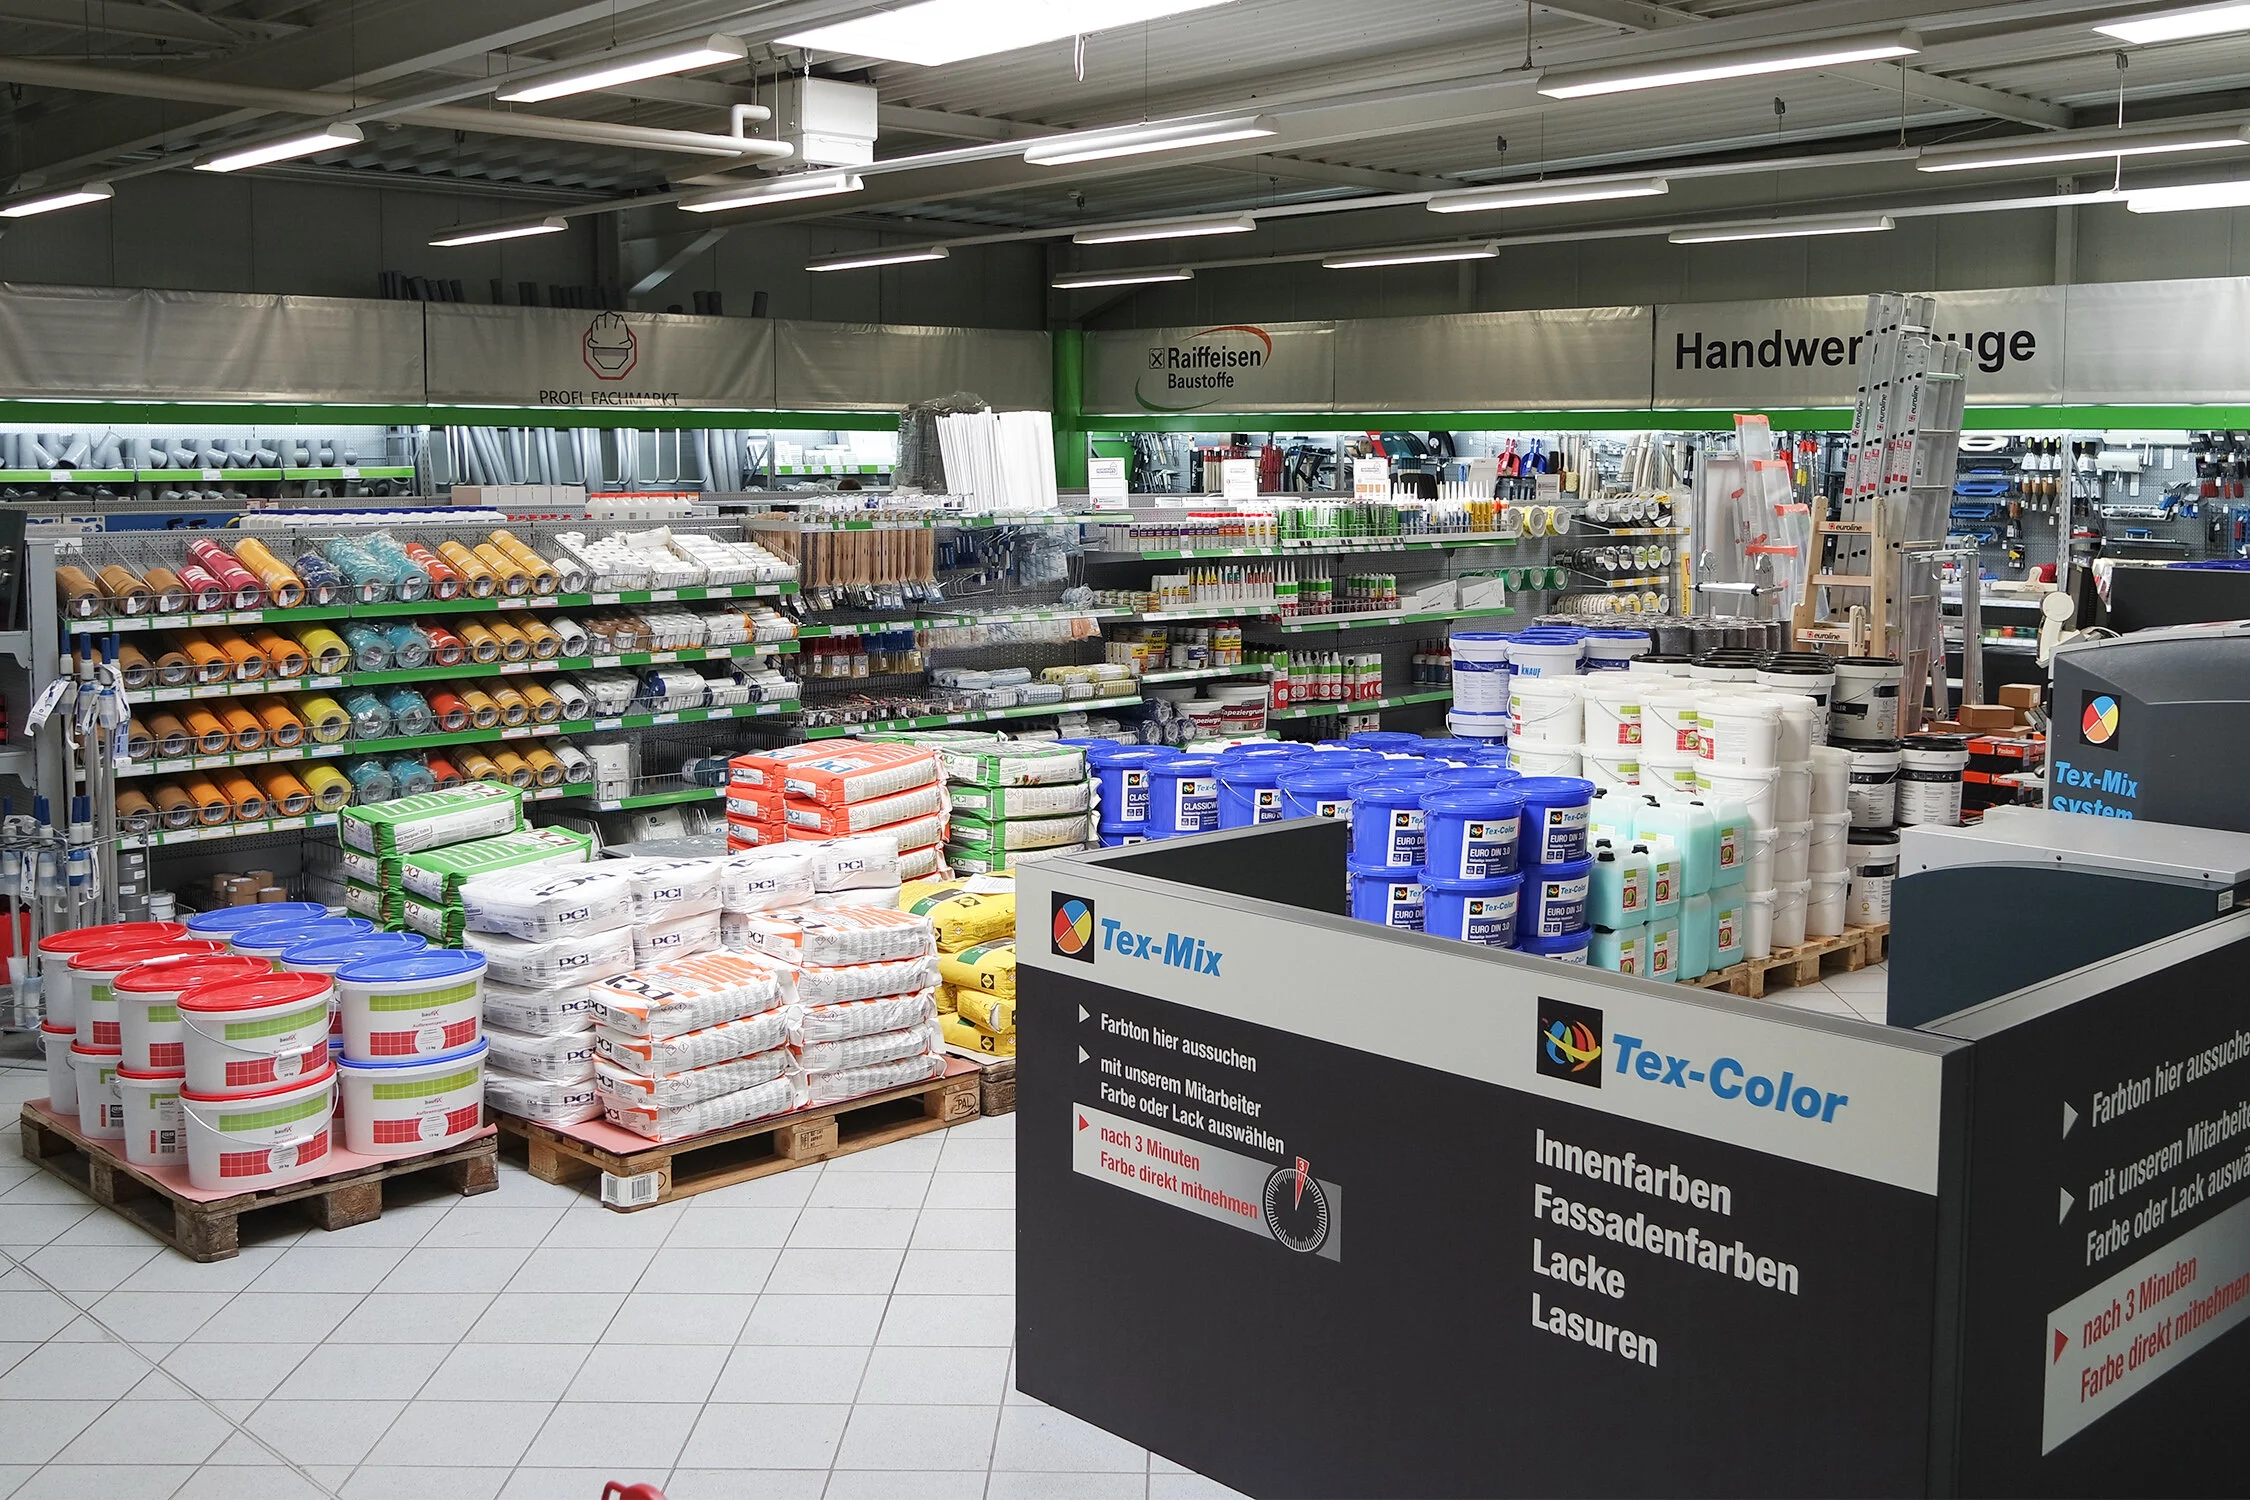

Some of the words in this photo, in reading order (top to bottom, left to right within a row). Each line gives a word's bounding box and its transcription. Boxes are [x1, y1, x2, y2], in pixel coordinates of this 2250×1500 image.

[1167, 345, 1262, 369] Raiffeisen
[1168, 371, 1235, 389] Baustoffe
[539, 390, 584, 405] PROFI
[591, 391, 679, 406] FACHMARKT
[1911, 385, 1920, 414] euroline
[1879, 394, 1888, 423] euroline
[1835, 523, 1862, 531] euroline
[1813, 631, 1841, 641] euroline
[1197, 784, 1217, 792] Tex-C
[2055, 761, 2139, 799] Tex-Mix
[1183, 802, 1218, 811] CLASSICW
[1485, 825, 1516, 835] Tex-Color
[1550, 834, 1568, 843] EURO
[1568, 833, 1577, 842] DIN
[1396, 836, 1416, 846] EURO
[1469, 848, 1489, 858] EURO
[1490, 848, 1501, 857] DIN
[1502, 846, 1511, 856] 3.0
[838, 860, 863, 871] PCI
[748, 880, 776, 892] PCI
[653, 888, 682, 901] PCI
[1394, 910, 1414, 919] EURO
[1484, 901, 1515, 912] Tex-Color
[1546, 906, 1564, 917] EURO
[1565, 905, 1575, 915] DIN
[1575, 903, 1583, 914] 3.0
[558, 907, 589, 923] PCI
[1469, 924, 1490, 934] EURO
[1491, 923, 1502, 933] DIN
[652, 934, 681, 948] PCI
[1101, 917, 1223, 977] Tex-Mix
[559, 953, 590, 968] PCI
[561, 1000, 589, 1013] PC
[588, 999, 607, 1016] PCI
[1101, 1013, 1149, 1044] Farbton
[1153, 1026, 1179, 1051] hier
[1182, 1037, 1257, 1073] aussuchen
[1612, 1034, 1849, 1124] Tex-Color
[1101, 1057, 1122, 1080] mit
[1125, 1066, 1181, 1095] unserem
[1186, 1078, 1262, 1119] Mitarbeiter
[2092, 1076, 2151, 1128] Farbton
[2155, 1062, 2183, 1093] hier
[564, 1092, 594, 1104] PCI
[1100, 1082, 1136, 1109] Farbe
[1139, 1097, 1169, 1119] oder
[1172, 1106, 1205, 1130] Lack
[1208, 1117, 1285, 1154] auswählen
[1101, 1127, 1131, 1149] nach
[1135, 1136, 1143, 1152] 3
[1147, 1139, 1200, 1172] Minuten
[1298, 1160, 1306, 1172] 3
[1535, 1128, 1732, 1217] Innenfarben
[2088, 1170, 2115, 1211] mit
[2119, 1140, 2183, 1196] unserem
[1100, 1151, 1135, 1178] Farbe
[1139, 1165, 1178, 1192] direkt
[1181, 1181, 1258, 1219] mitnehmen
[2086, 1219, 2130, 1267] Farbe
[2134, 1199, 2167, 1233] oder
[2170, 1172, 2205, 1219] Lack
[1534, 1184, 1799, 1296] Fassadenfarben
[1533, 1238, 1626, 1300] Lacke
[2082, 1297, 2121, 1349] nach
[2125, 1298, 2136, 1320] 3
[2139, 1256, 2197, 1315] Minuten
[1532, 1292, 1658, 1368] Lasuren
[2080, 1354, 2125, 1404] Farbe
[2128, 1325, 2171, 1372] direkt
[2175, 1271, 2250, 1341] mitnehmen
